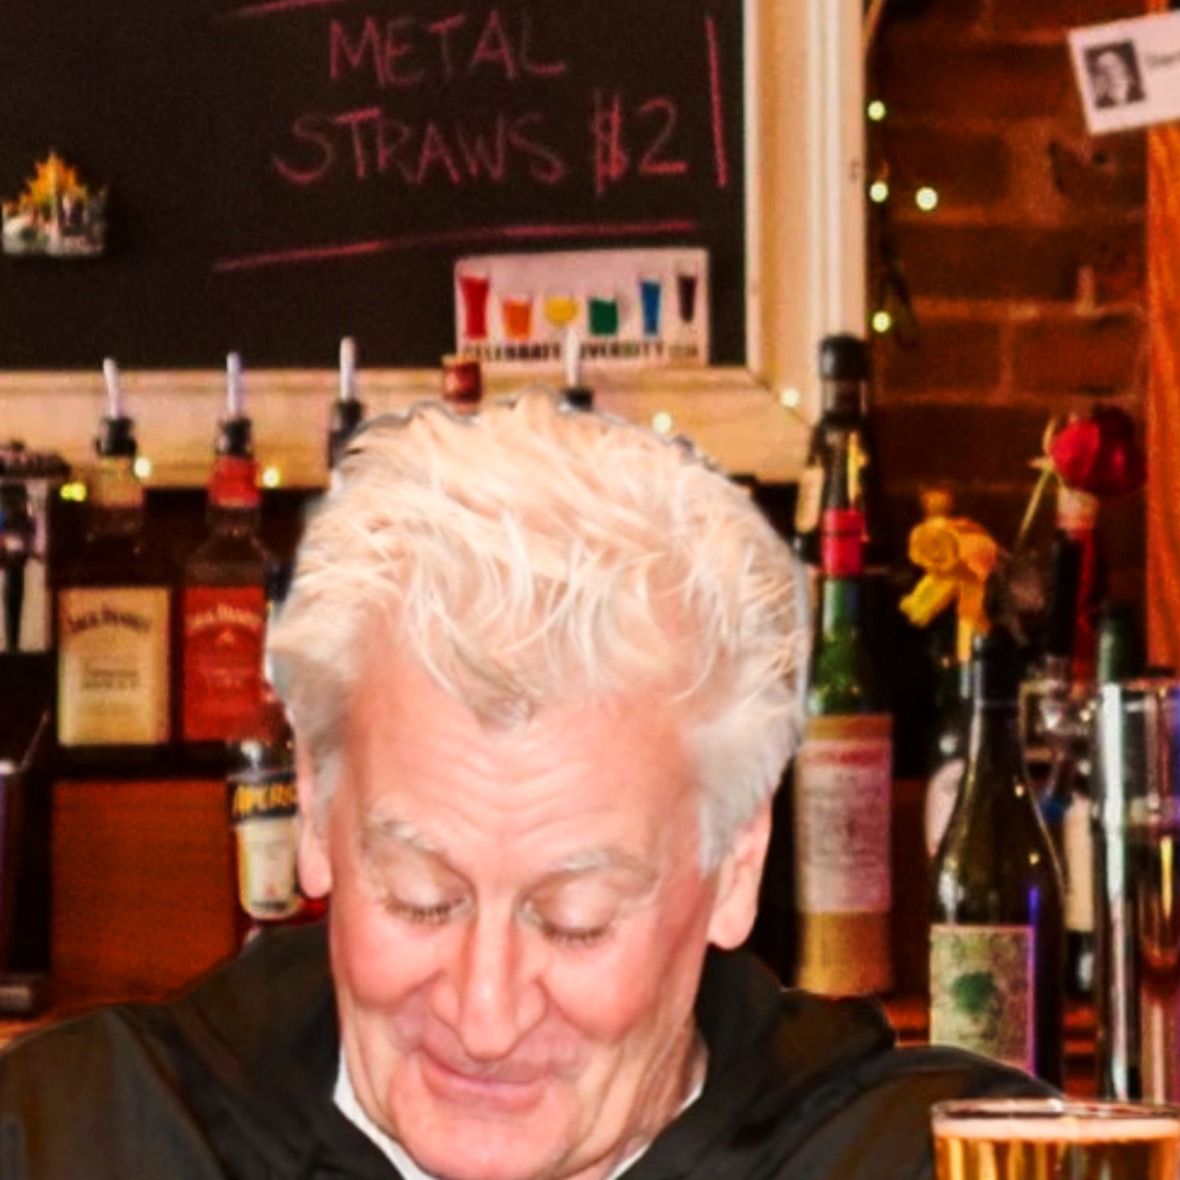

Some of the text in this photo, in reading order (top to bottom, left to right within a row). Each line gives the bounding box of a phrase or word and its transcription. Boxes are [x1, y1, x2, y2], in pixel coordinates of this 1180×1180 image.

[328, 10, 568, 87] METAL
[272, 94, 689, 194] STRAWS $2
[580, 340, 665, 360] IVERSITY
